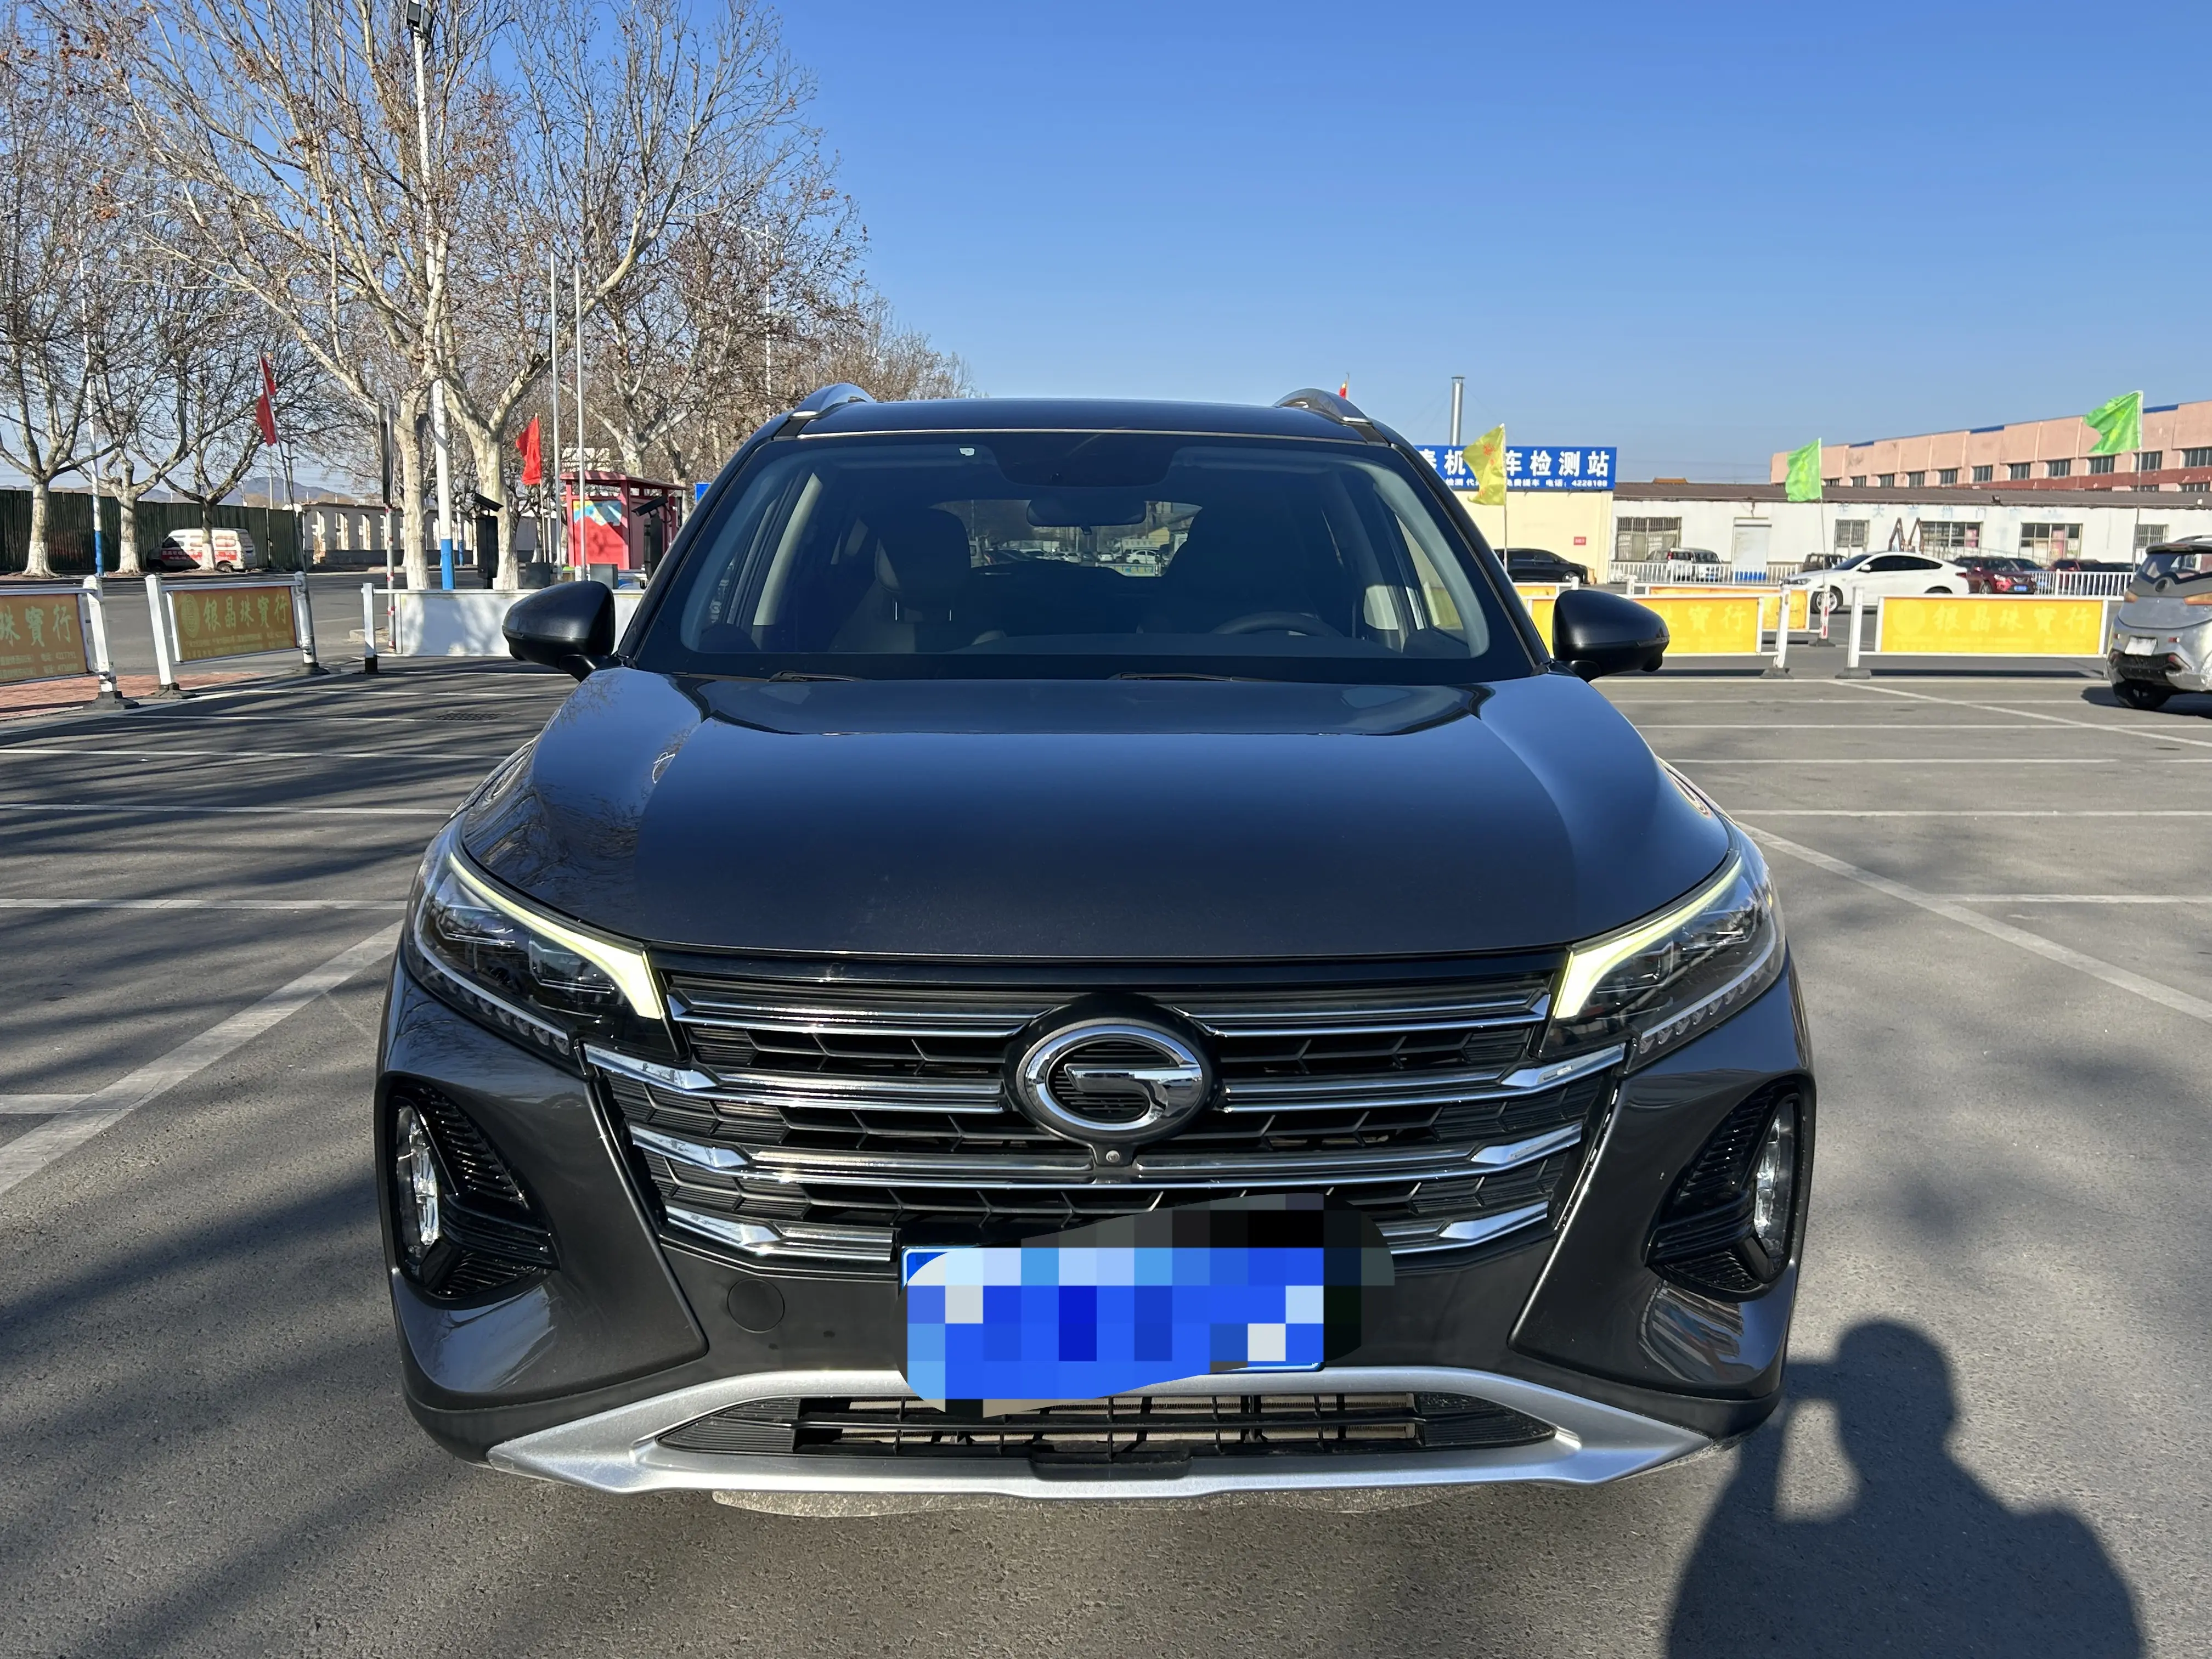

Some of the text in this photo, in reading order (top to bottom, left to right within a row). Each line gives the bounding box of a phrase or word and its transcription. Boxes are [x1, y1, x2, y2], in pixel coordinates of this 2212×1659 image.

[1418, 448, 1610, 477] 机车检测站
